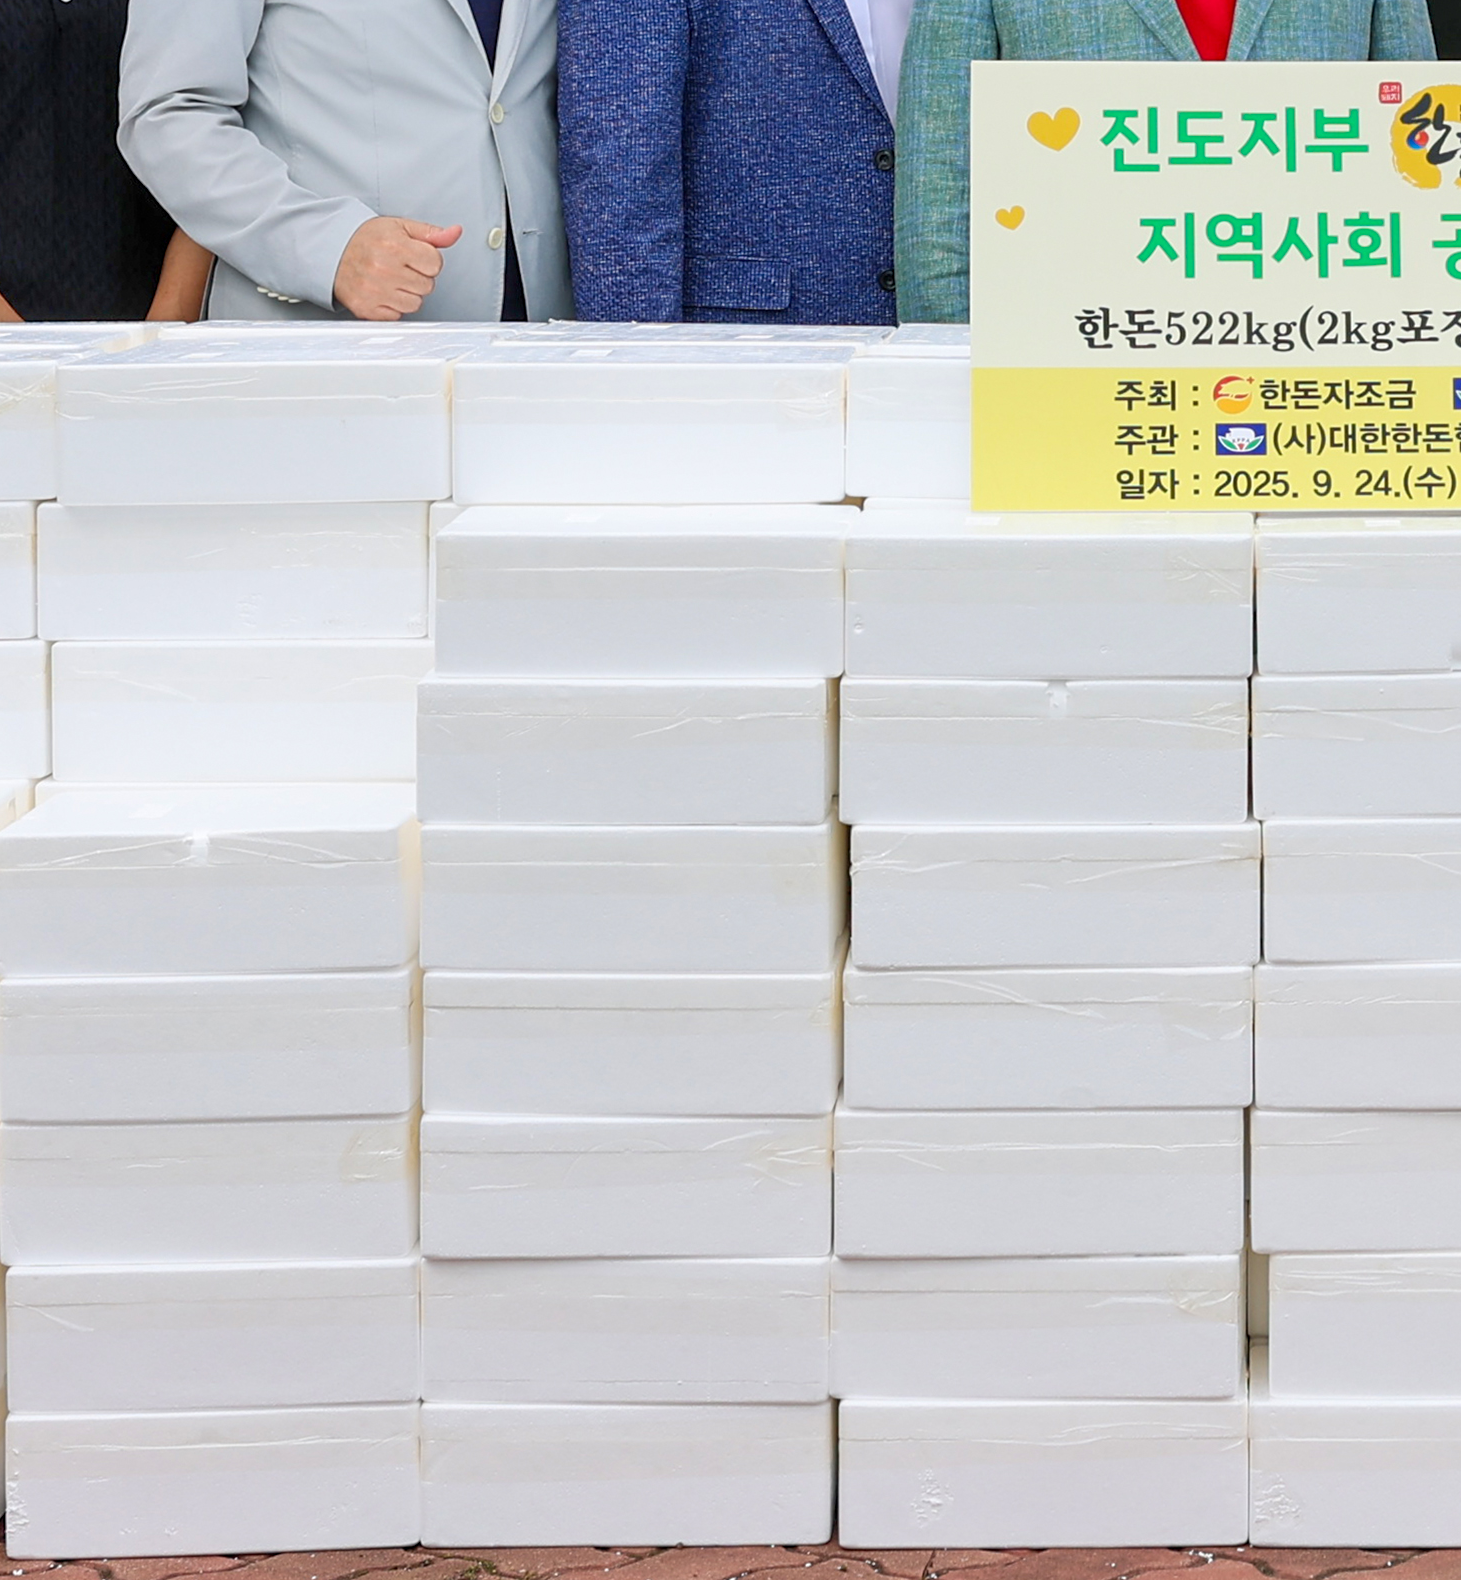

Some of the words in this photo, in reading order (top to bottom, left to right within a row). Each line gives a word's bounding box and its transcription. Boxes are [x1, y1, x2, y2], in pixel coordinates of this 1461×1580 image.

[1099, 106, 1369, 173] 진도지부
[1137, 211, 1403, 280] 지역사회
[1114, 380, 1176, 411] 주최
[1259, 379, 1417, 410] 한돈자조금
[1114, 424, 1179, 456] 주관
[1116, 469, 1180, 500] 일자
[1214, 470, 1299, 498] 2025.
[1312, 470, 1341, 498] 9.
[1355, 466, 1457, 499] 24.(수)
